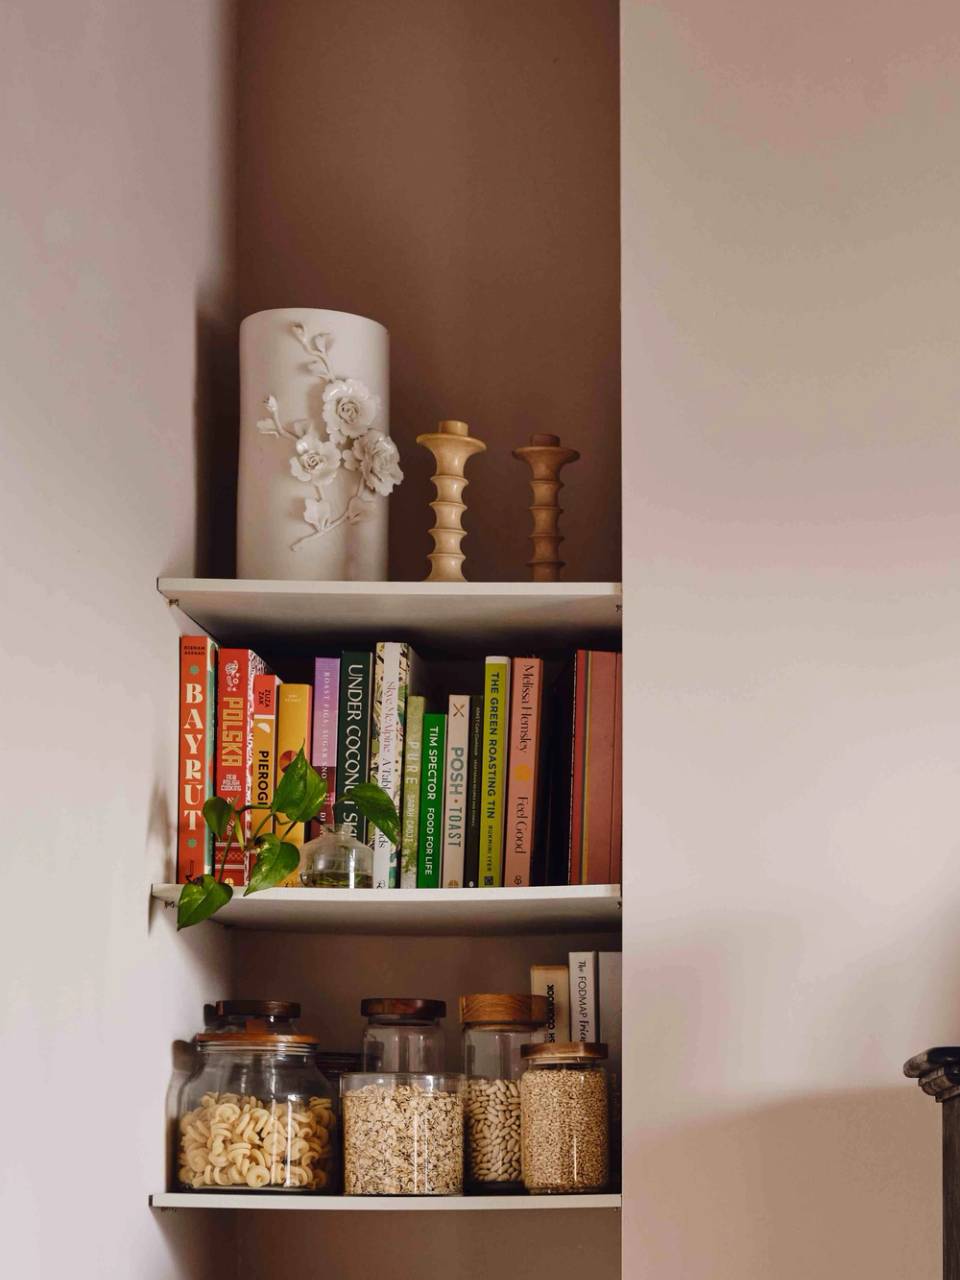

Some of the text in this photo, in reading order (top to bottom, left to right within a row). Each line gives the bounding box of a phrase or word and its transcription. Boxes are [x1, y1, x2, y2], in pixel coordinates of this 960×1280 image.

[264, 689, 272, 708] ZUZA
[346, 664, 364, 721] UNDER
[490, 672, 499, 694] THE
[222, 697, 244, 767] POLSKA
[380, 681, 396, 792] Skye McAlpine A Tabl
[488, 697, 499, 735] GREEN
[321, 730, 329, 759] SUGAR
[405, 740, 419, 785] PURE
[514, 664, 535, 854] Melissa Hemsley Feel Good
[258, 751, 270, 806] PIEROGI
[320, 761, 328, 780] SNO
[487, 739, 497, 797] ROASTING
[424, 726, 439, 875] TIM SPECTOR FOOD FOR LIFE
[448, 746, 465, 848] POSH TOAST
[486, 800, 496, 819] TIN
[577, 976, 588, 1018] FODMAP
[578, 1020, 590, 1042] Frien
